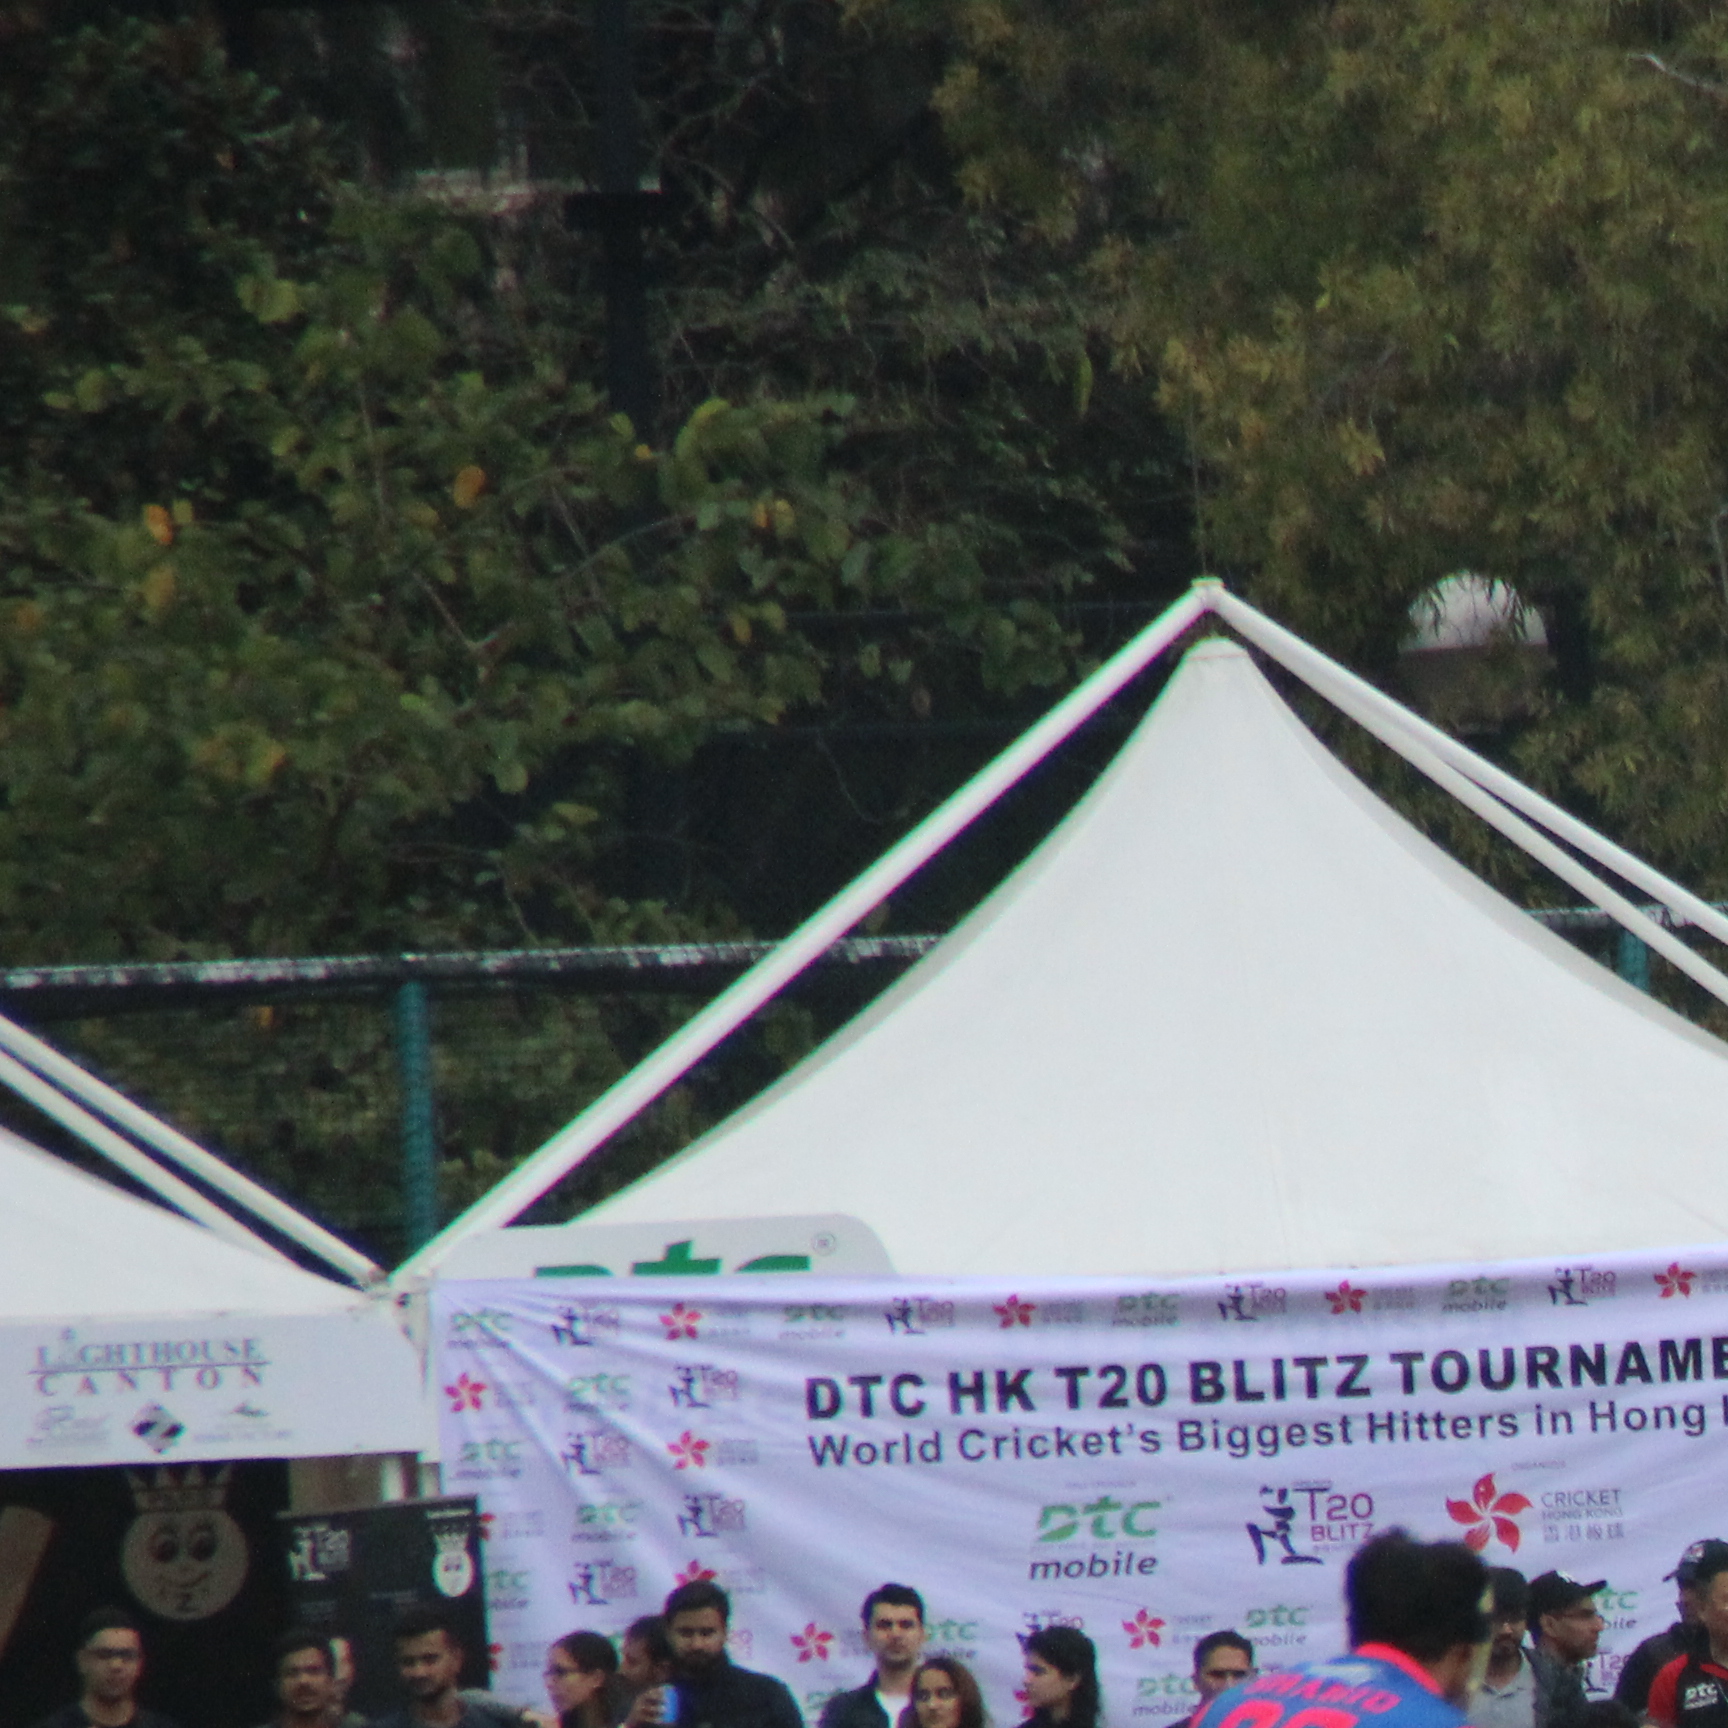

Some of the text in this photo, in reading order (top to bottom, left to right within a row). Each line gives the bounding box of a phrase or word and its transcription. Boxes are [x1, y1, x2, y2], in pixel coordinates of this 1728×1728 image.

[36, 1366, 262, 1397] CANTON
[805, 1372, 926, 1420] DTC
[947, 1367, 1036, 1415] HK
[1053, 1362, 1169, 1411] T20
[1188, 1354, 1372, 1405] BLITZ
[808, 1430, 944, 1467] World
[957, 1422, 1163, 1462] Cricket's
[1177, 1412, 1353, 1458] Biggest
[1367, 1410, 1519, 1442] Hitters
[1534, 1403, 1574, 1436] in
[1589, 1398, 1707, 1438] Hong
[1292, 1486, 1375, 1522] T20
[1541, 1488, 1622, 1508] CRICKET
[1310, 1522, 1374, 1543] BLITZ
[1029, 1551, 1158, 1580] mobile
